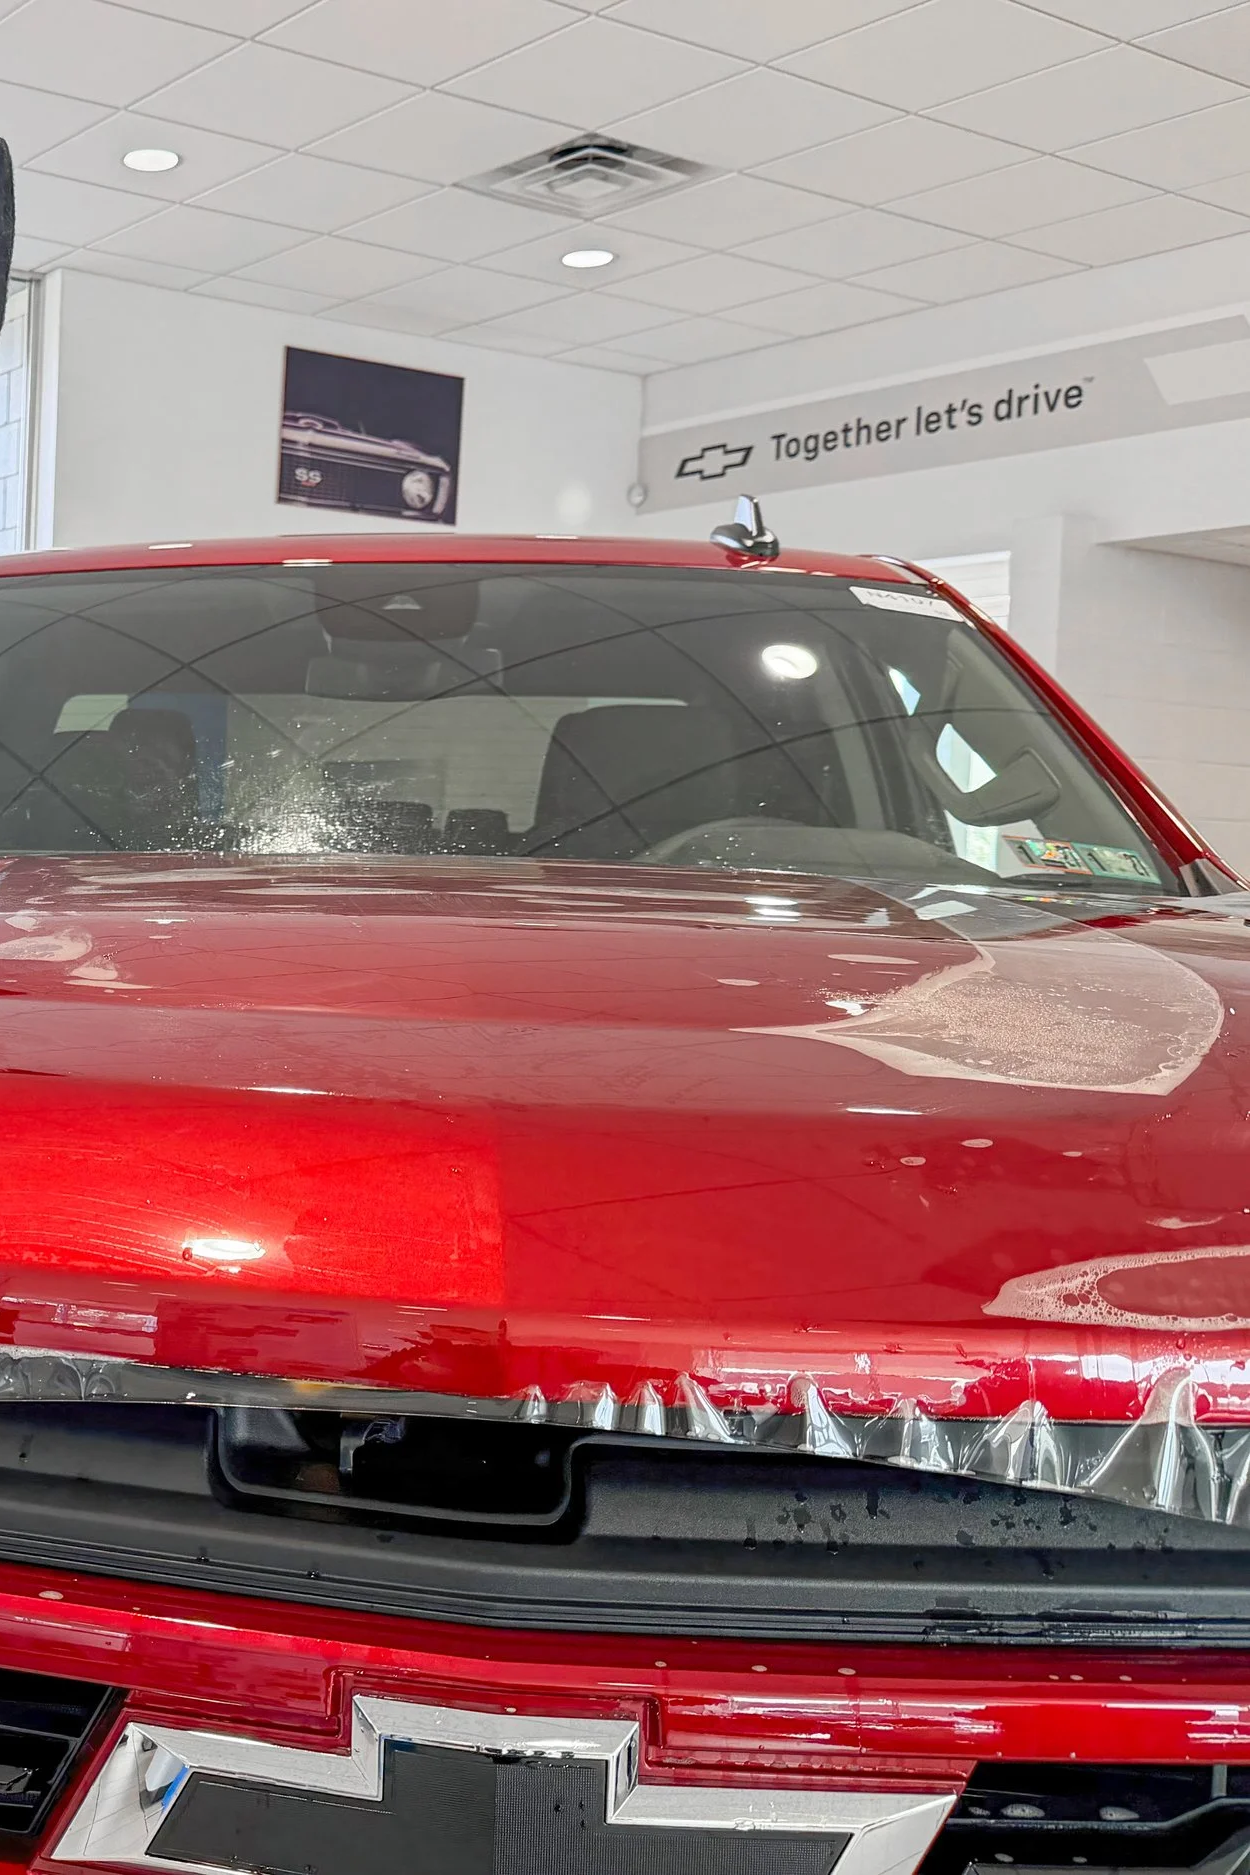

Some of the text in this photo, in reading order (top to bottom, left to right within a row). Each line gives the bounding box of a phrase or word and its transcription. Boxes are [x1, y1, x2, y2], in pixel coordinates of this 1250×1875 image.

[770, 417, 908, 461] Together
[915, 399, 983, 436] let's
[295, 467, 322, 484] SS
